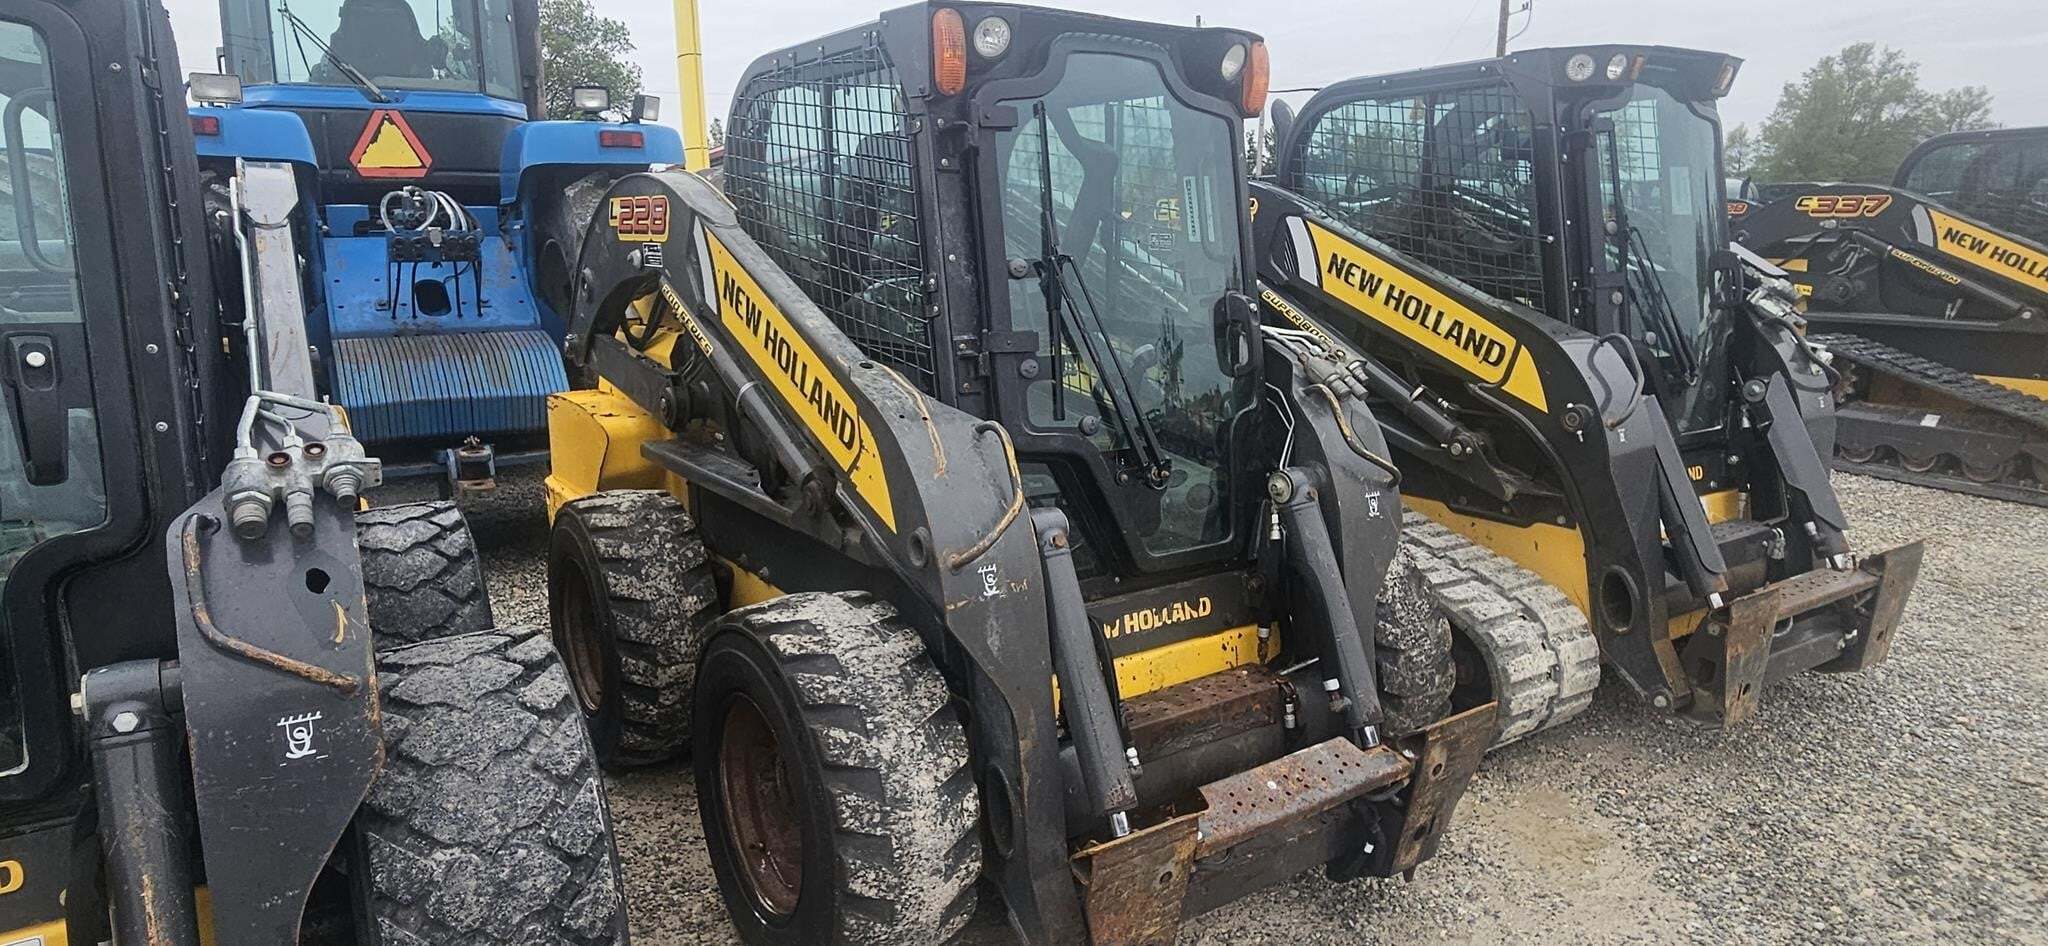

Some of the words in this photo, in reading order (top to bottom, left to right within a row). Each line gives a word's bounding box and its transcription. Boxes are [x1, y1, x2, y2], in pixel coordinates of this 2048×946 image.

[610, 197, 668, 237] L228
[1796, 196, 1891, 216] C337
[1943, 227, 1990, 255] NEW
[1262, 290, 1303, 325] SUPER
[1327, 252, 1384, 299] NEW
[1383, 283, 1507, 367] HOLLAND
[723, 271, 763, 338] NEW
[763, 318, 856, 451] HOLLAND
[1123, 596, 1212, 634] HOLLAND
